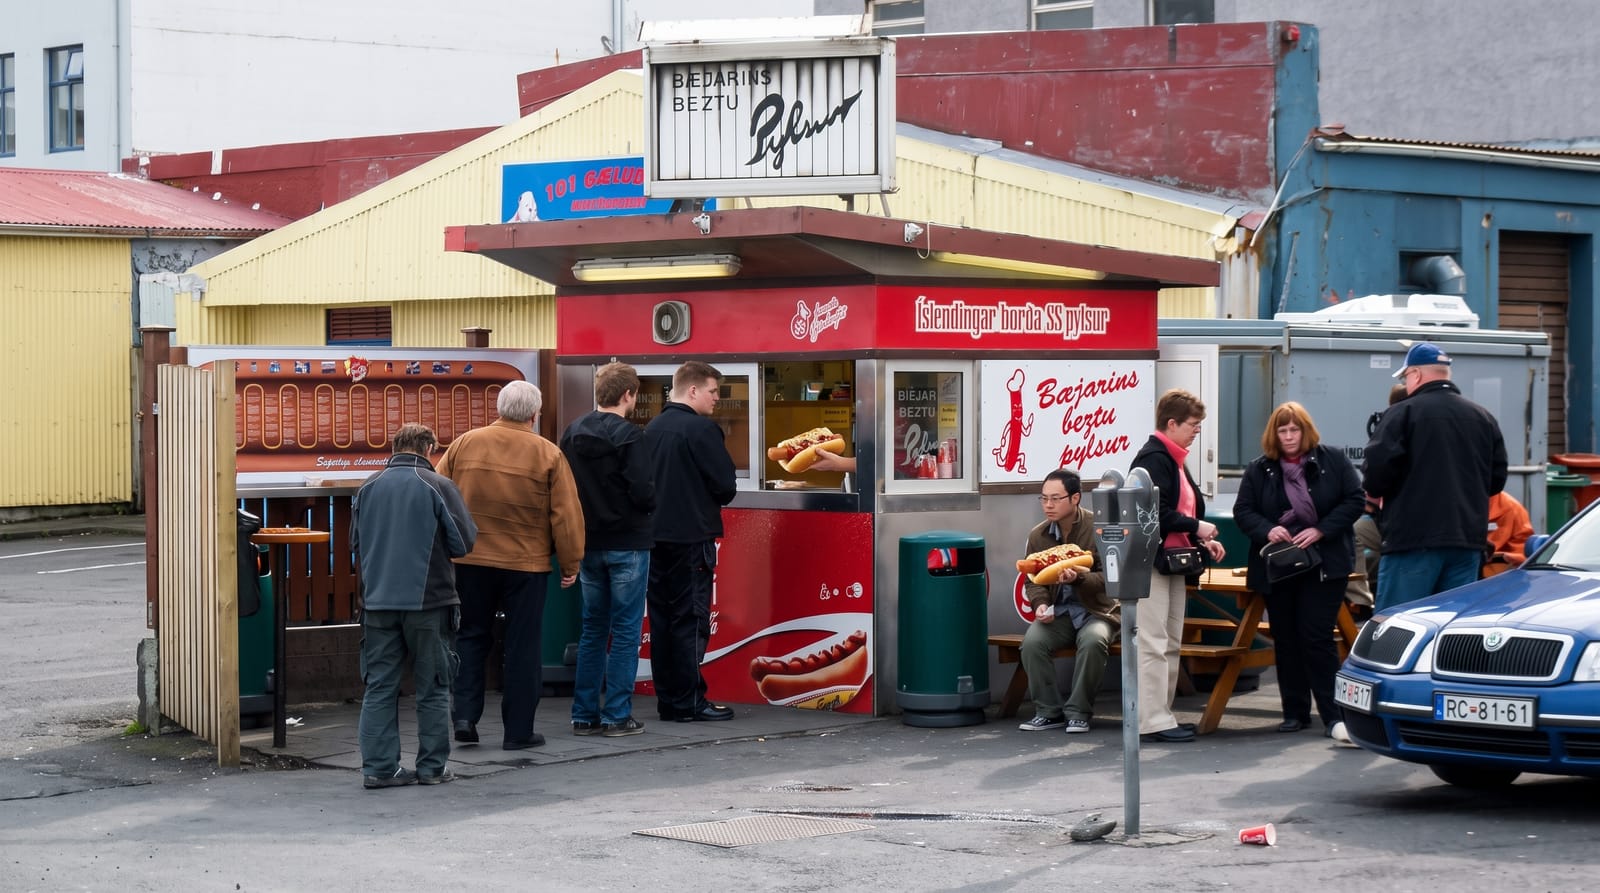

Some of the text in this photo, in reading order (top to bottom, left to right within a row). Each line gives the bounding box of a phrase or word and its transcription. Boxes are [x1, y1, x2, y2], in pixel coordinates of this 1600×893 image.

[672, 70, 772, 89] BÆJARINS
[673, 95, 739, 112] BEZTU
[545, 174, 576, 202] 101
[916, 296, 998, 339] Íslendingar
[1045, 303, 1063, 334] SS
[1064, 303, 1110, 340] pylsur
[1036, 370, 1139, 409] Bæjarins
[899, 407, 936, 418] BEZTU
[1062, 405, 1116, 439] beztu
[1059, 433, 1130, 471] pylsur
